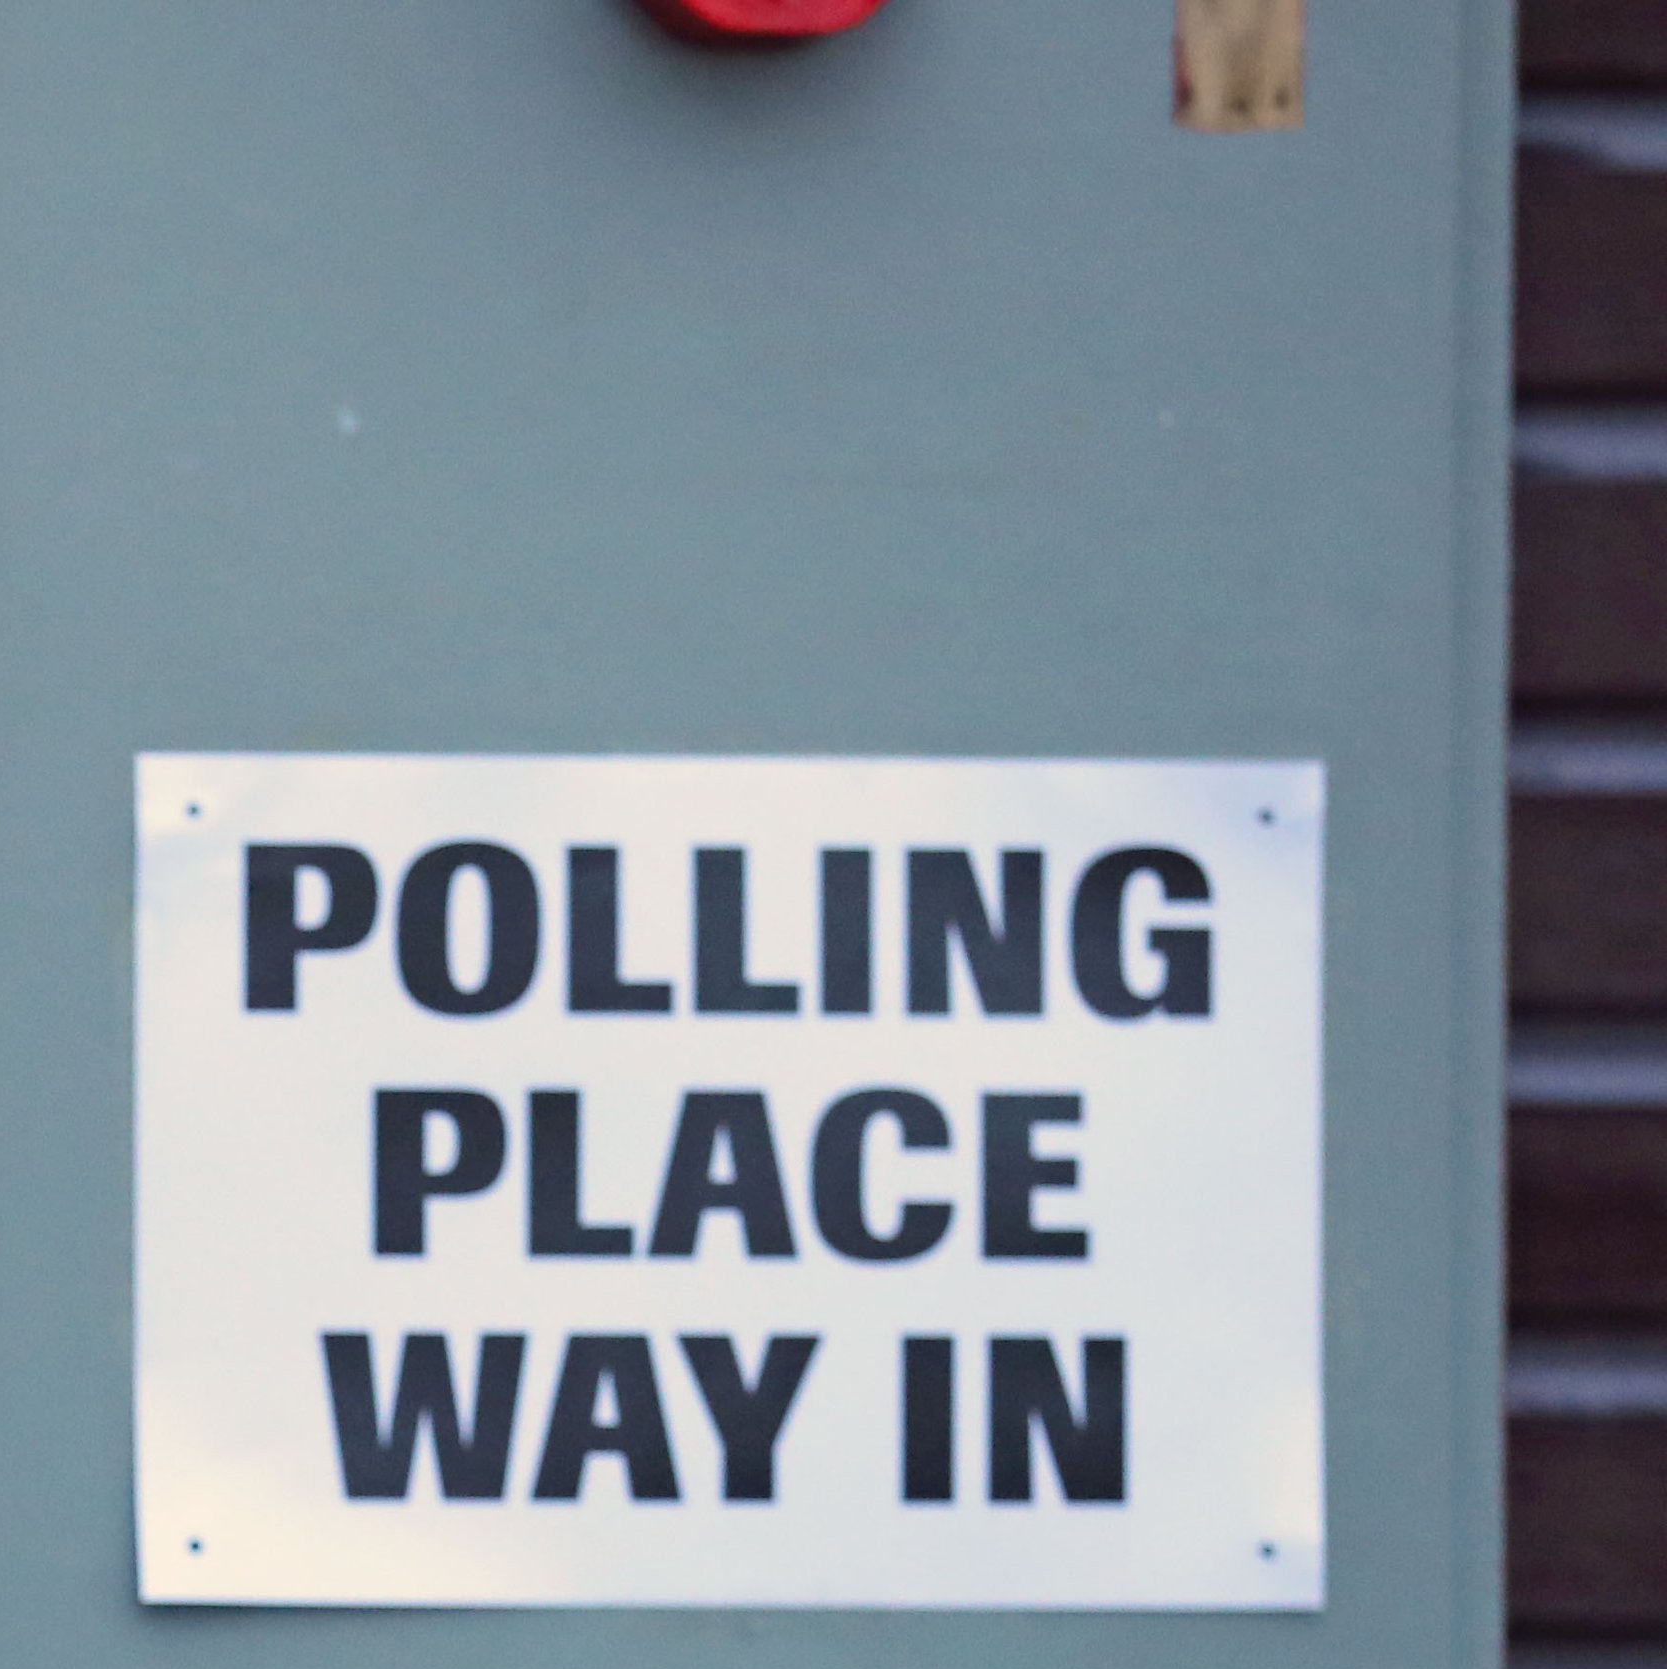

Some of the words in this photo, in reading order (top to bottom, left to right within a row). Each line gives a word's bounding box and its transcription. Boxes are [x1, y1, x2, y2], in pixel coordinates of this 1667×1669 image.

[243, 839, 1214, 1022] POLLING
[372, 1086, 1091, 1265] PLACE
[319, 1330, 823, 1504] WAY
[900, 1333, 1128, 1506] IN
